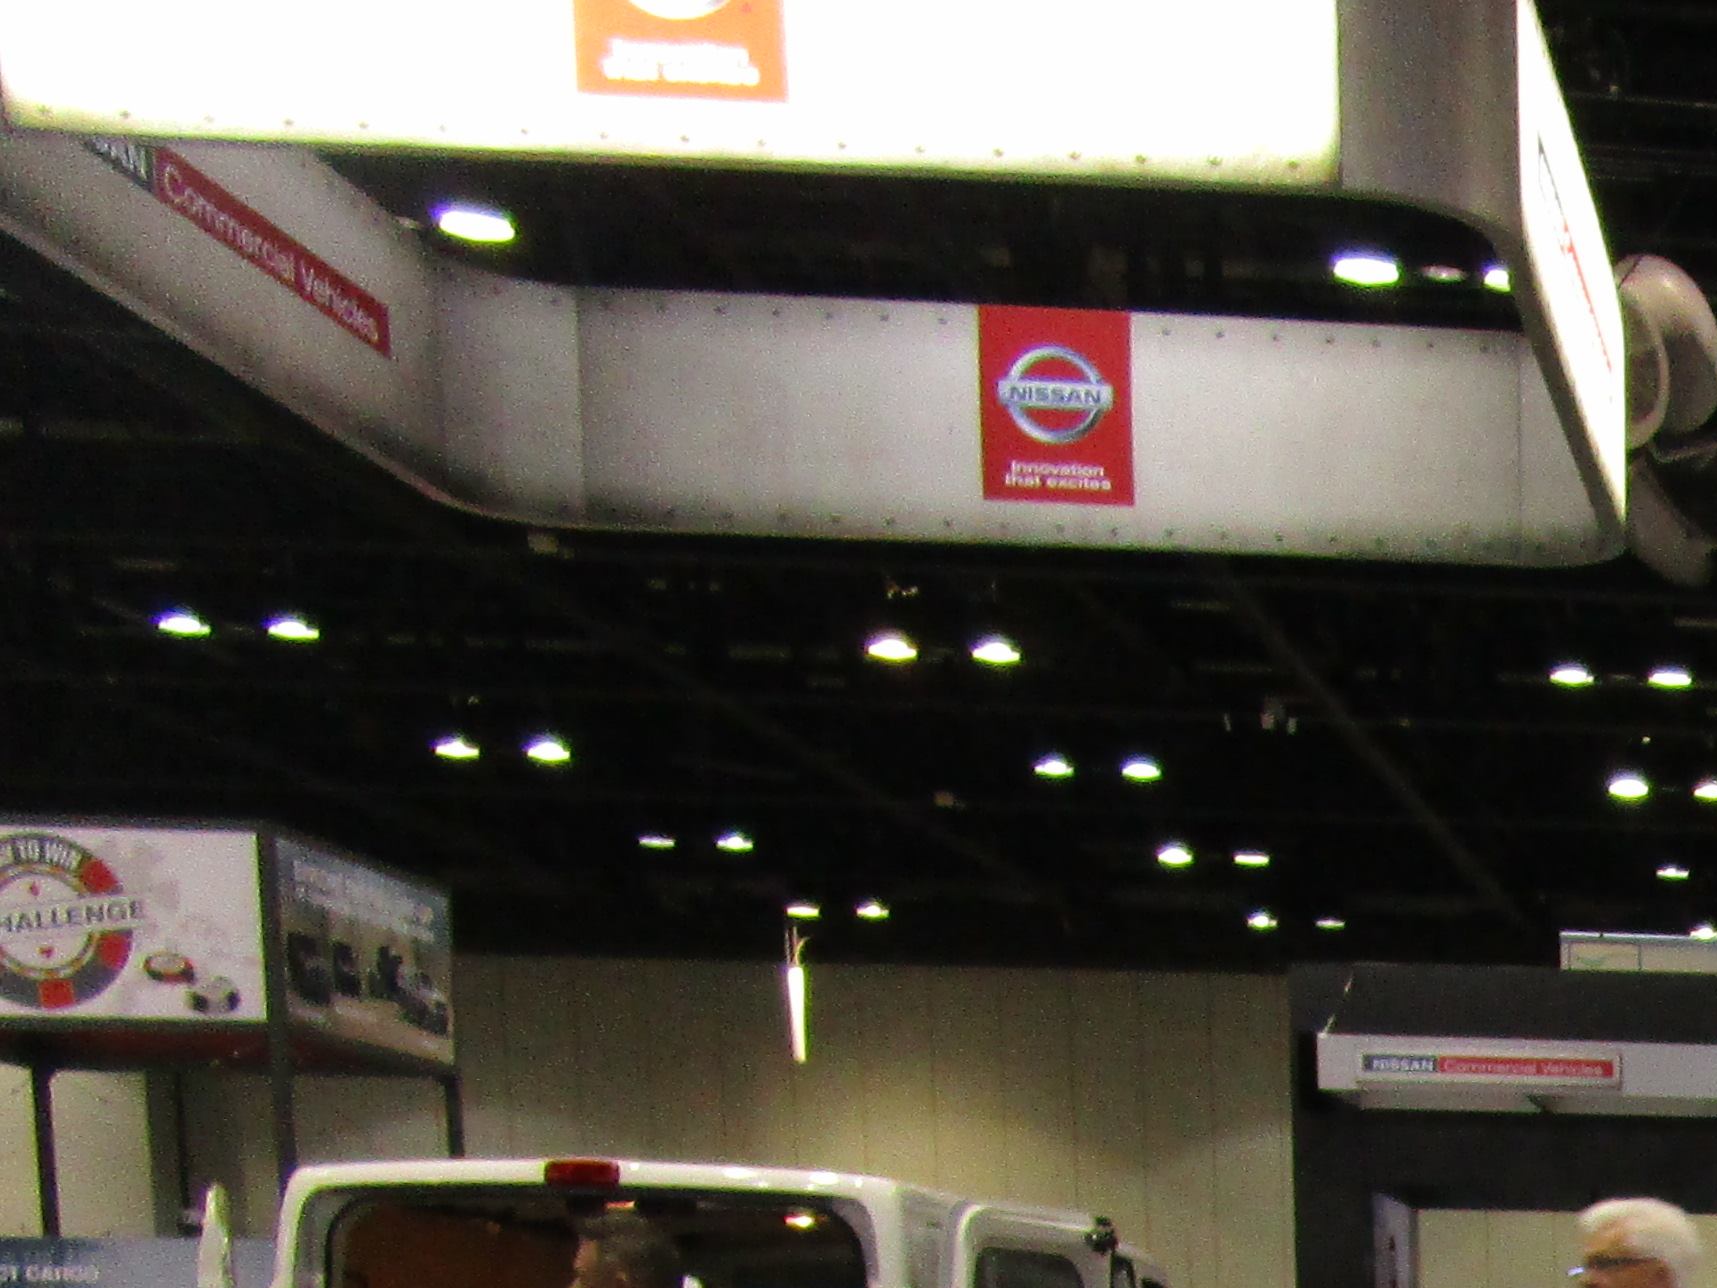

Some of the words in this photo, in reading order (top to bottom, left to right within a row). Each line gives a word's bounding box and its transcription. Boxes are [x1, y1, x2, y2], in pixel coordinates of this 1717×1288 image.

[164, 164, 295, 283] Commercial
[297, 259, 380, 344] Vehicles
[1009, 385, 1102, 405] NISSAN
[1011, 460, 1105, 477] Innovation
[1005, 473, 1041, 488] that
[1046, 475, 1113, 491] excites
[1372, 1057, 1434, 1073] NISSAN
[1443, 1059, 1537, 1075] Commercial
[1542, 1062, 1603, 1077] Vehicles
